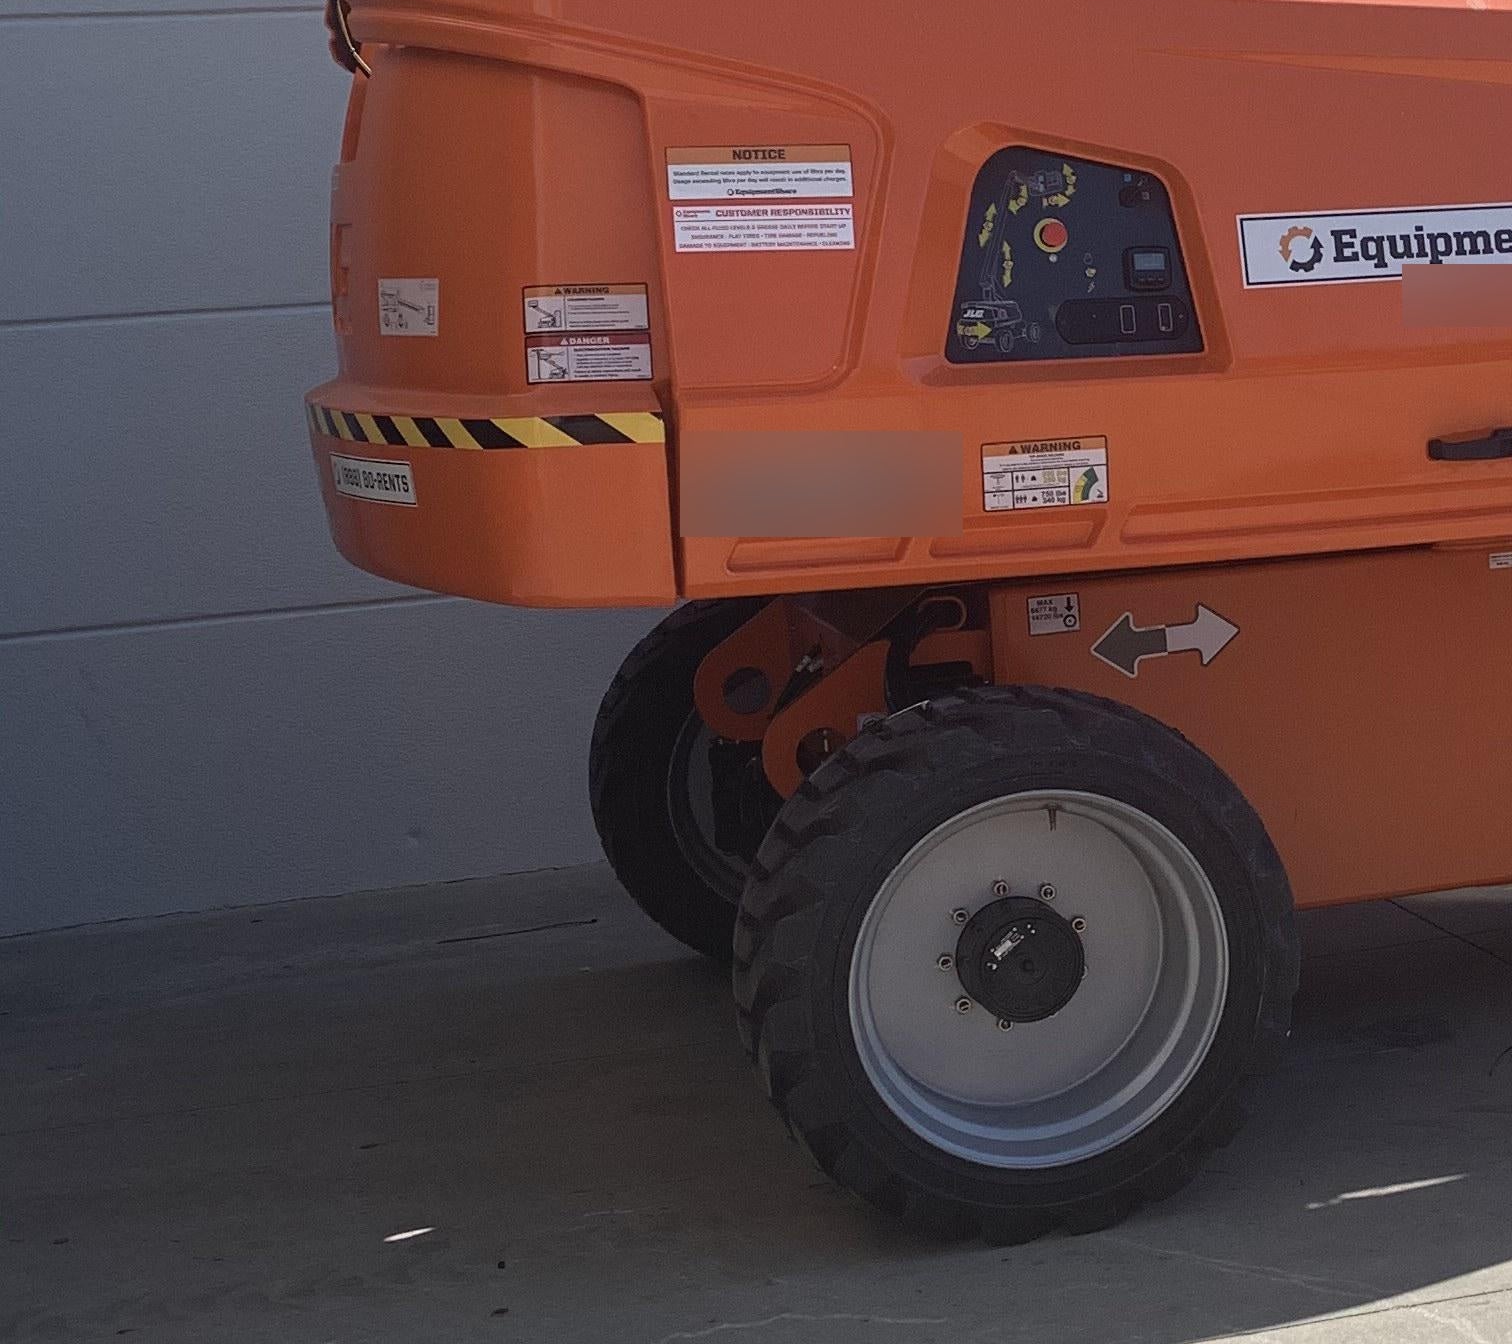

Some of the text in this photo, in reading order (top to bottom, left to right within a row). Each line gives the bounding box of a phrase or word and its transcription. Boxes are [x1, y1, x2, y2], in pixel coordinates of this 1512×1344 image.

[732, 149, 787, 161] NOTICE
[715, 208, 851, 218] CUSTOMER RESPONSIBILITY
[563, 287, 610, 295] WARNING
[569, 337, 611, 345] DANGER
[1020, 441, 1081, 454] WARNING
